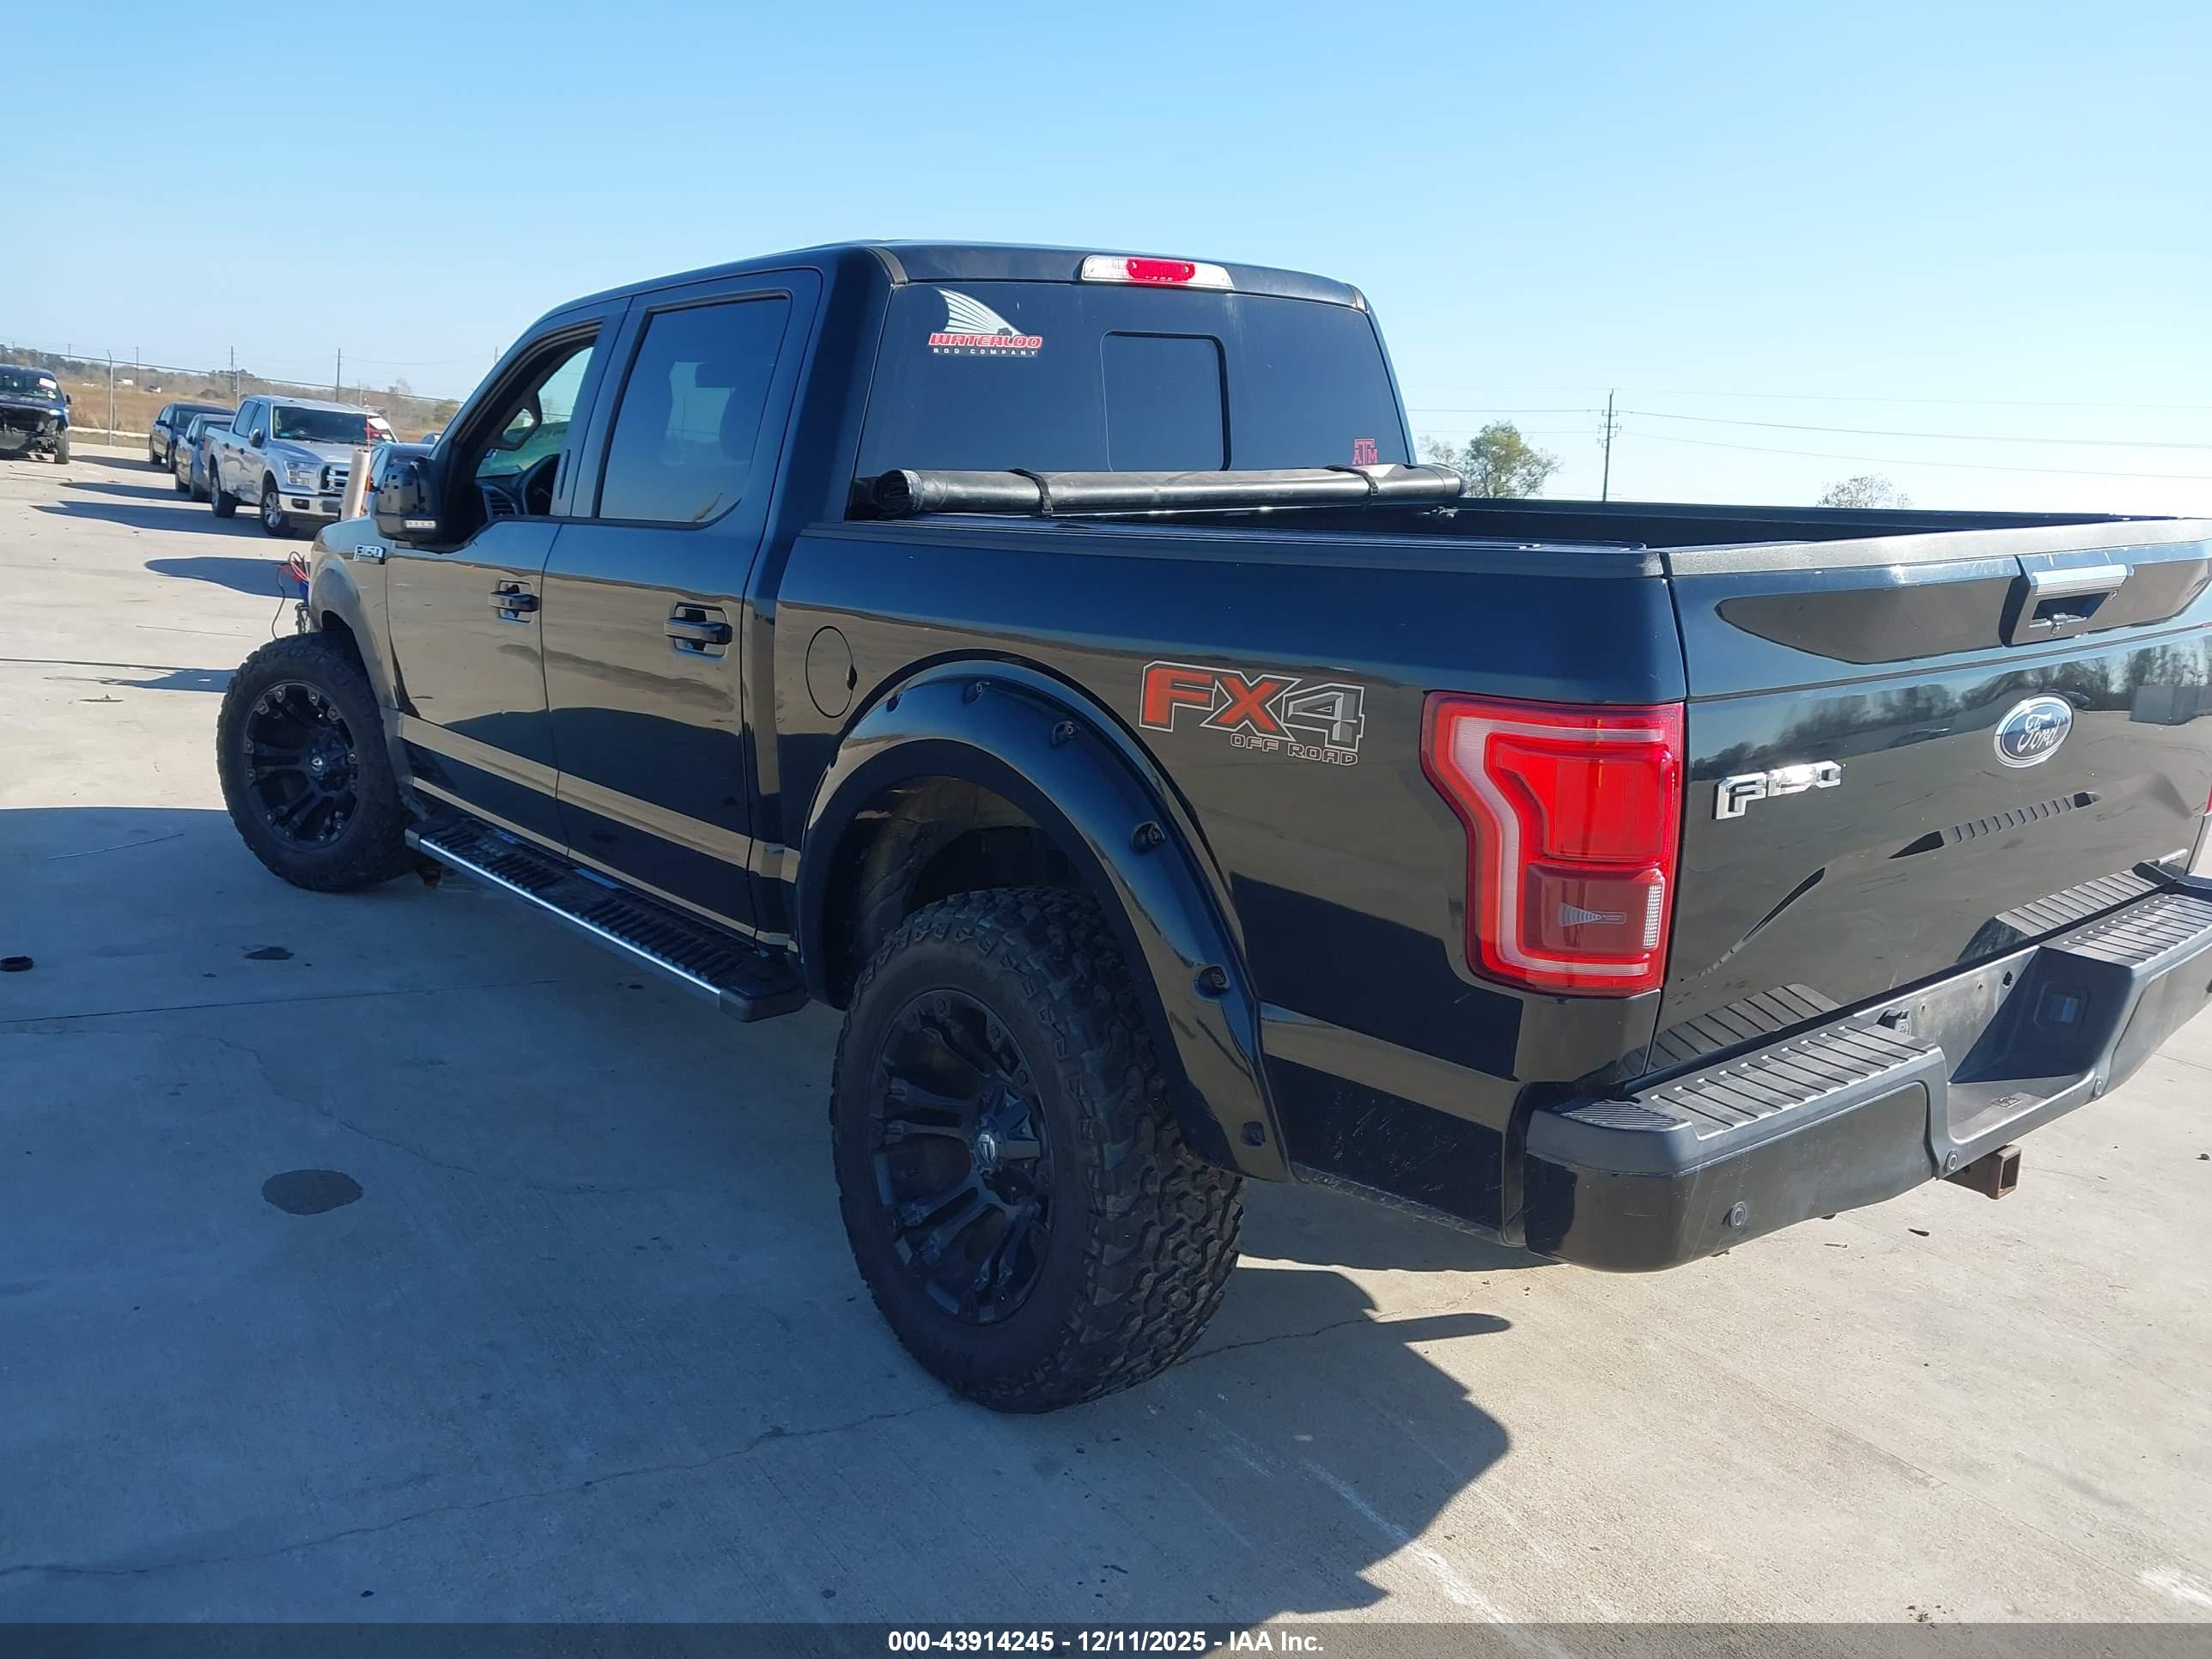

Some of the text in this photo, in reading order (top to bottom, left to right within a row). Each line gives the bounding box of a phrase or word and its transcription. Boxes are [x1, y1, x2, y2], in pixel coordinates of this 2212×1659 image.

[928, 332, 1043, 349] WATERLOO
[1139, 660, 1365, 751] FX4
[1230, 733, 1358, 767] OFF ROAD
[2016, 713, 2062, 753] Ford
